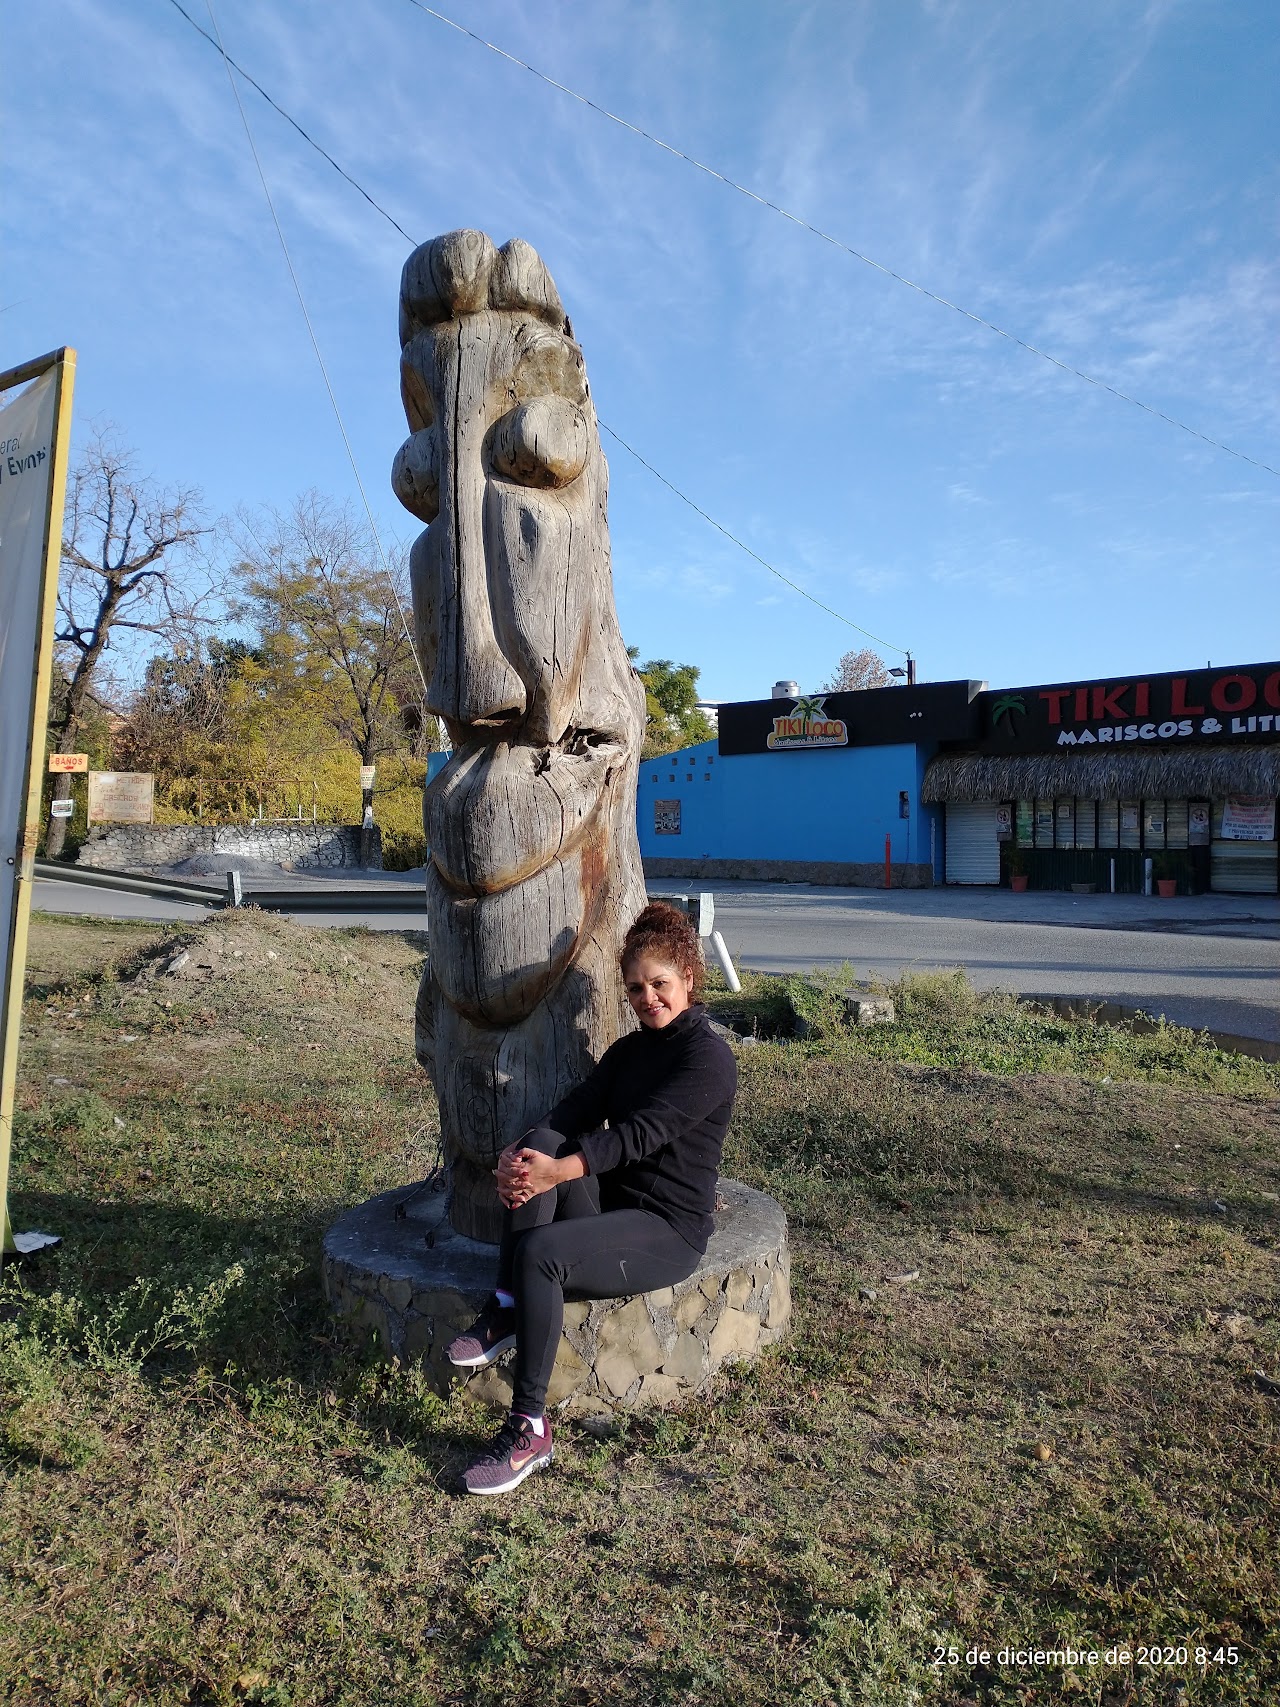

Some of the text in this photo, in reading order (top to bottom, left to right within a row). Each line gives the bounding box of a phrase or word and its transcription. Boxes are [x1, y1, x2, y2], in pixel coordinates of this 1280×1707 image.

[1039, 682, 1149, 724] TIKI
[776, 718, 843, 736] TIKI LOCO
[1057, 720, 1193, 746] MARISCOS
[1201, 717, 1223, 734] &
[55, 756, 83, 766] BAÑOS
